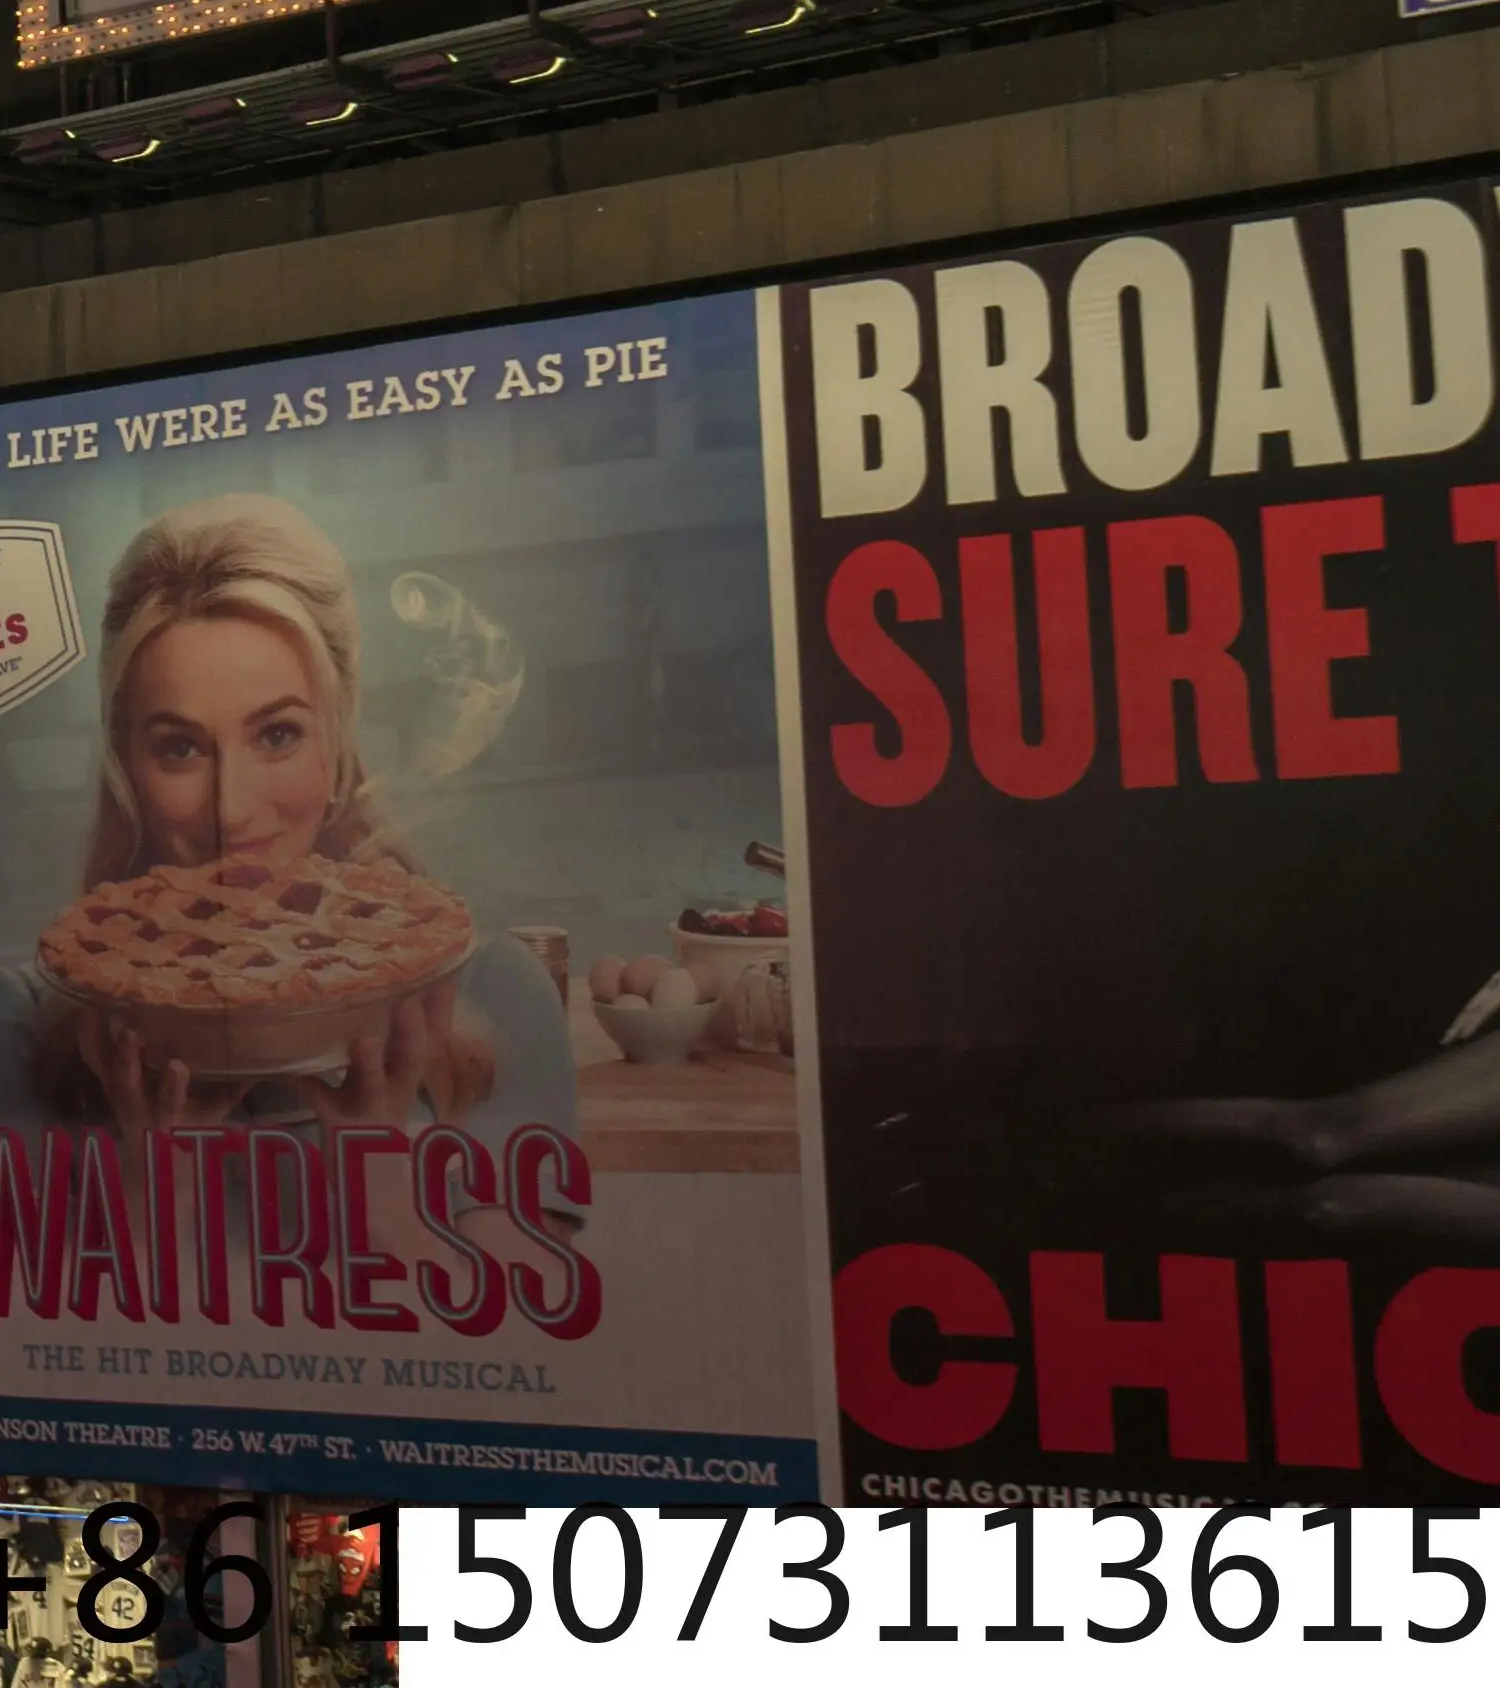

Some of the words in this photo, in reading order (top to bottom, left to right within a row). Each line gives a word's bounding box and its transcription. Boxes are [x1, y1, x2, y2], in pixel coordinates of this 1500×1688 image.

[6, 421, 100, 472] LIFE
[117, 399, 247, 453] WERE
[265, 387, 329, 431] AS
[345, 365, 476, 421] EASY
[495, 354, 564, 401] AS
[583, 337, 669, 389] PIE
[826, 495, 1401, 808] SURE
[24, 1344, 83, 1372] THE
[100, 1346, 152, 1376] HIT
[167, 1350, 368, 1384] BROADWAY
[382, 1359, 558, 1393] MUSICAL
[64, 1421, 173, 1449] THEATRE
[192, 1428, 235, 1452] 256
[238, 1431, 265, 1454] W.
[324, 1436, 357, 1460] ST.
[379, 1439, 779, 1486] WAITRESSTHEMUSICAL.COM
[112, 1596, 135, 1620] 42
